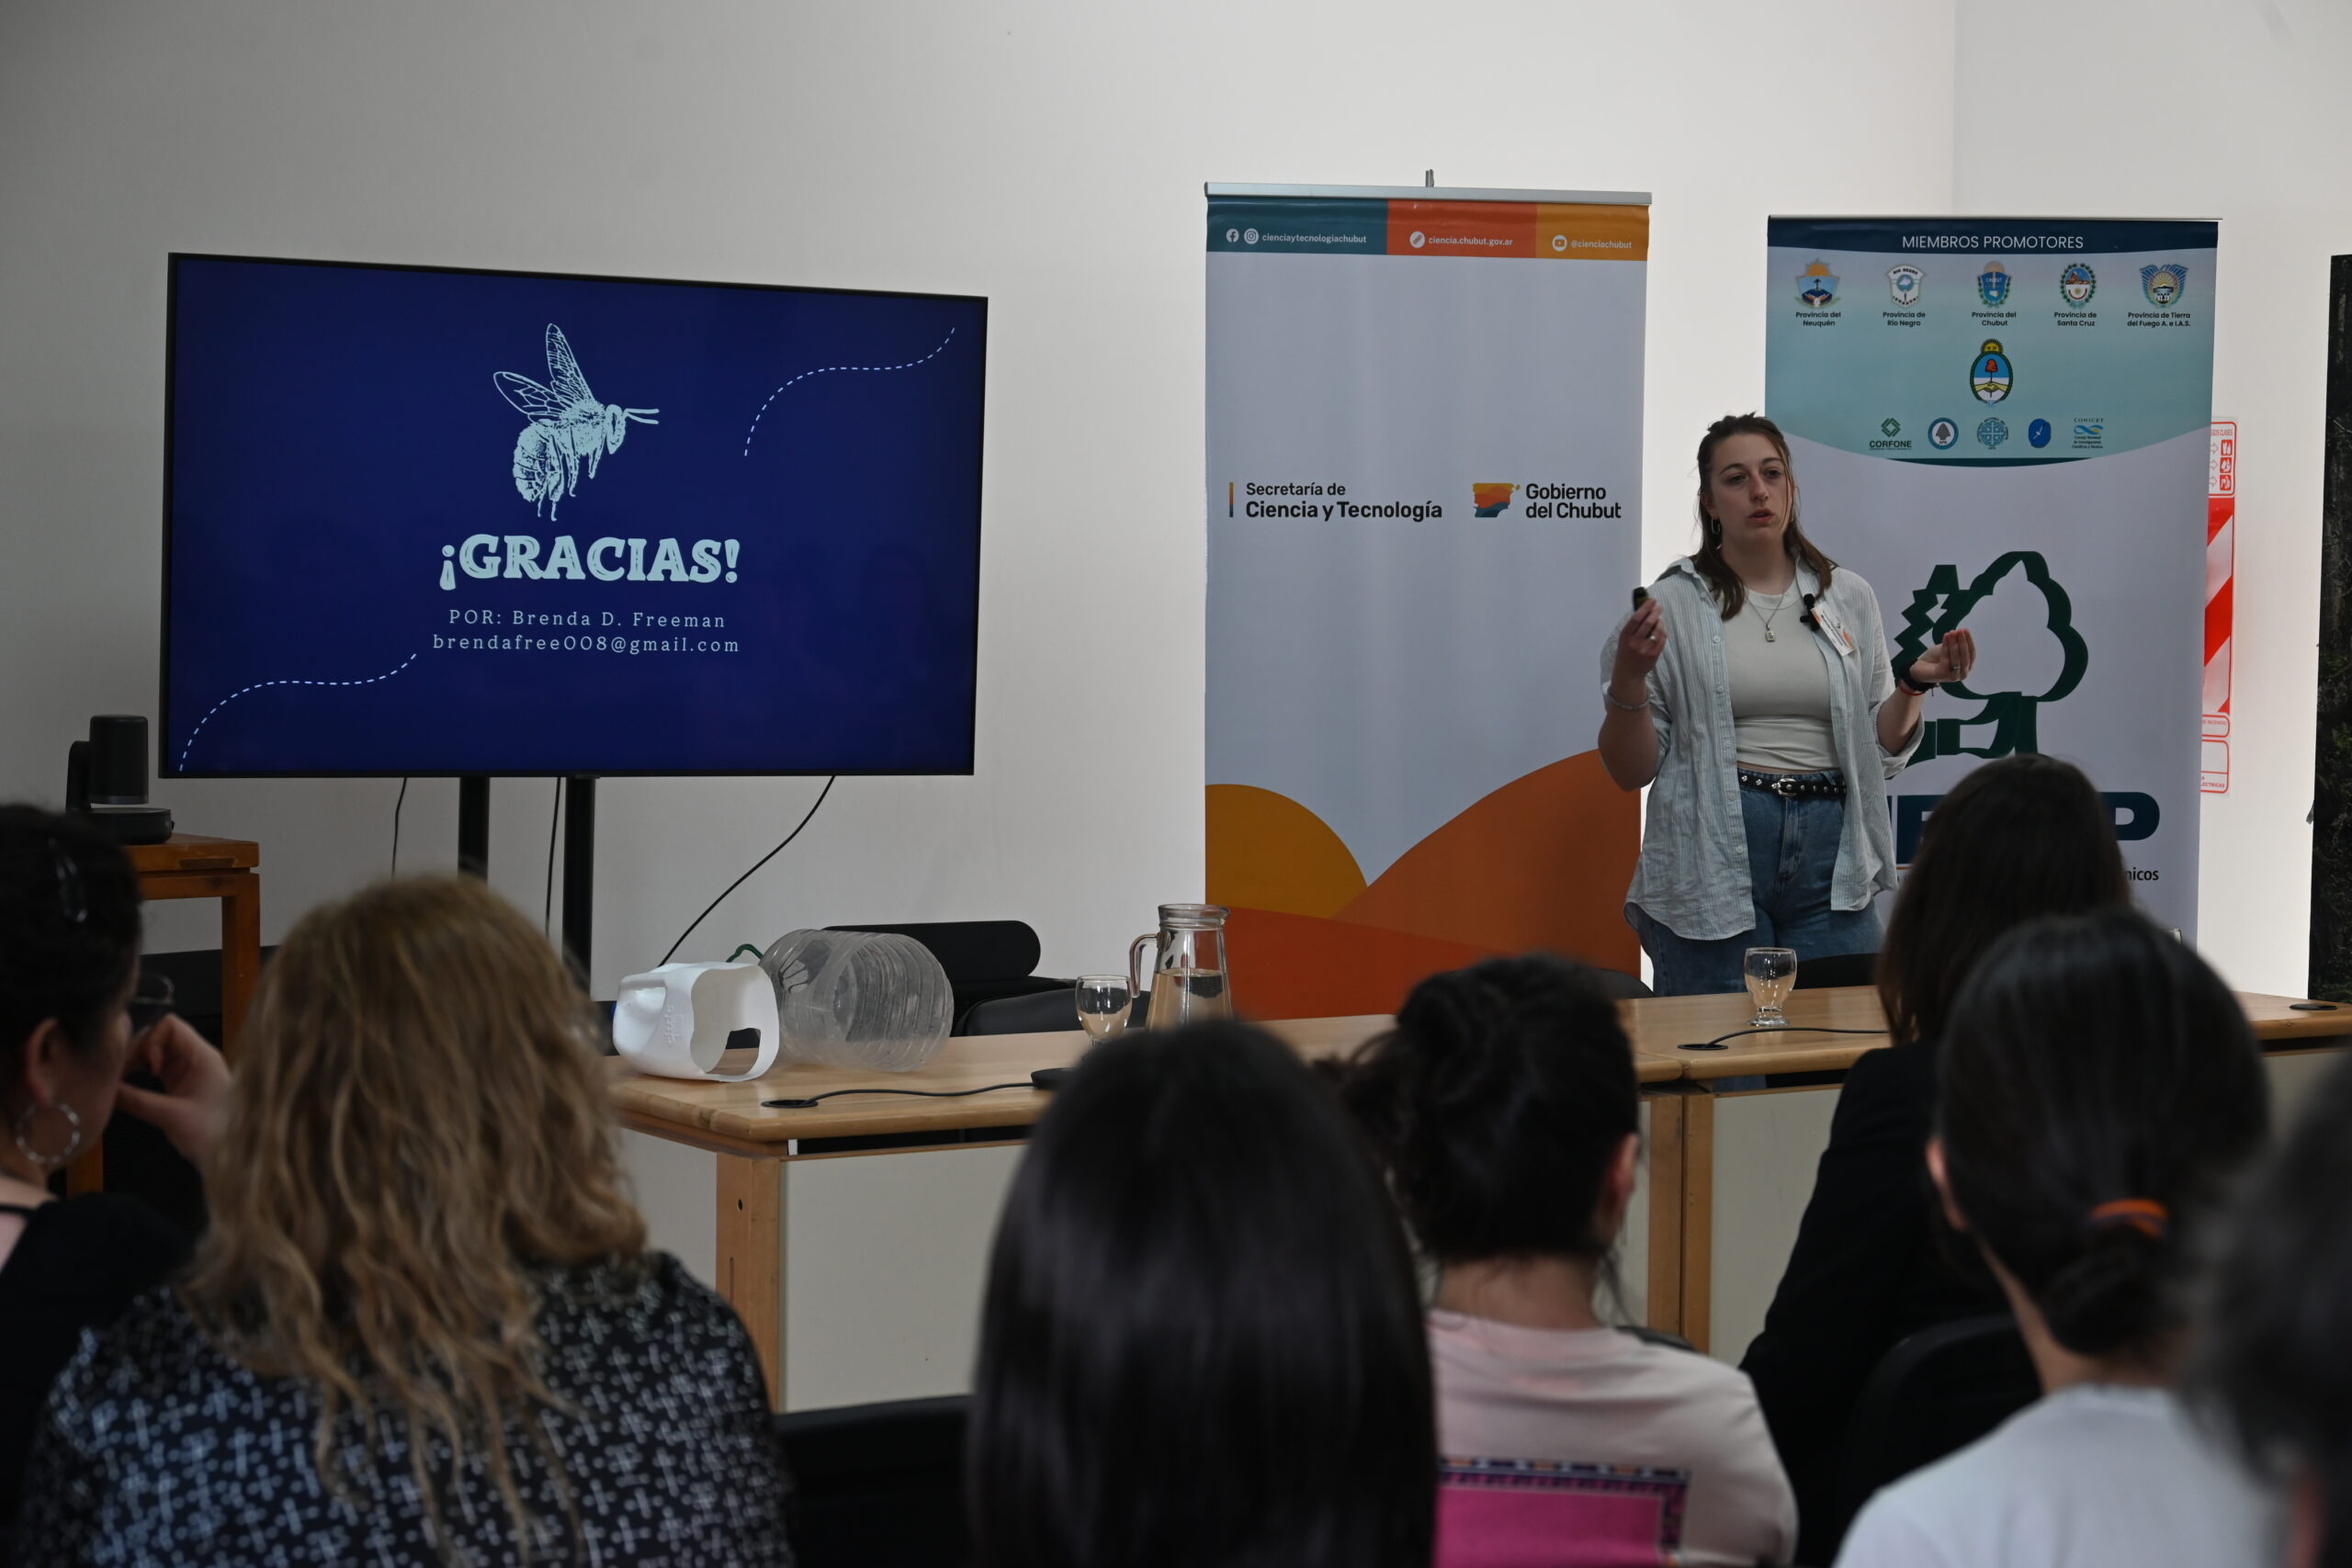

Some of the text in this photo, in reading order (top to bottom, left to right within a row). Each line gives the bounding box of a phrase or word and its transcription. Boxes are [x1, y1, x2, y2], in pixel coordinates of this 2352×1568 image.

[1261, 232, 1367, 244] cienciaytecnologiachubut
[1428, 234, 1513, 247] ciencia.chubut.gov.ar
[1570, 239, 1633, 250] @cienciachubut
[1902, 235, 2084, 249] MIEMBROS PROMOTORES
[1869, 440, 1912, 448] CORFONE
[1246, 481, 1346, 497] Secretaría de
[1525, 483, 1607, 500] Gobierno
[1246, 500, 1442, 522] Ciencia y Tecnología
[1525, 502, 1622, 519] del Chubut
[439, 534, 741, 591] ¡GRACIAS!
[449, 609, 725, 627] POR: Brenda D. Freeman
